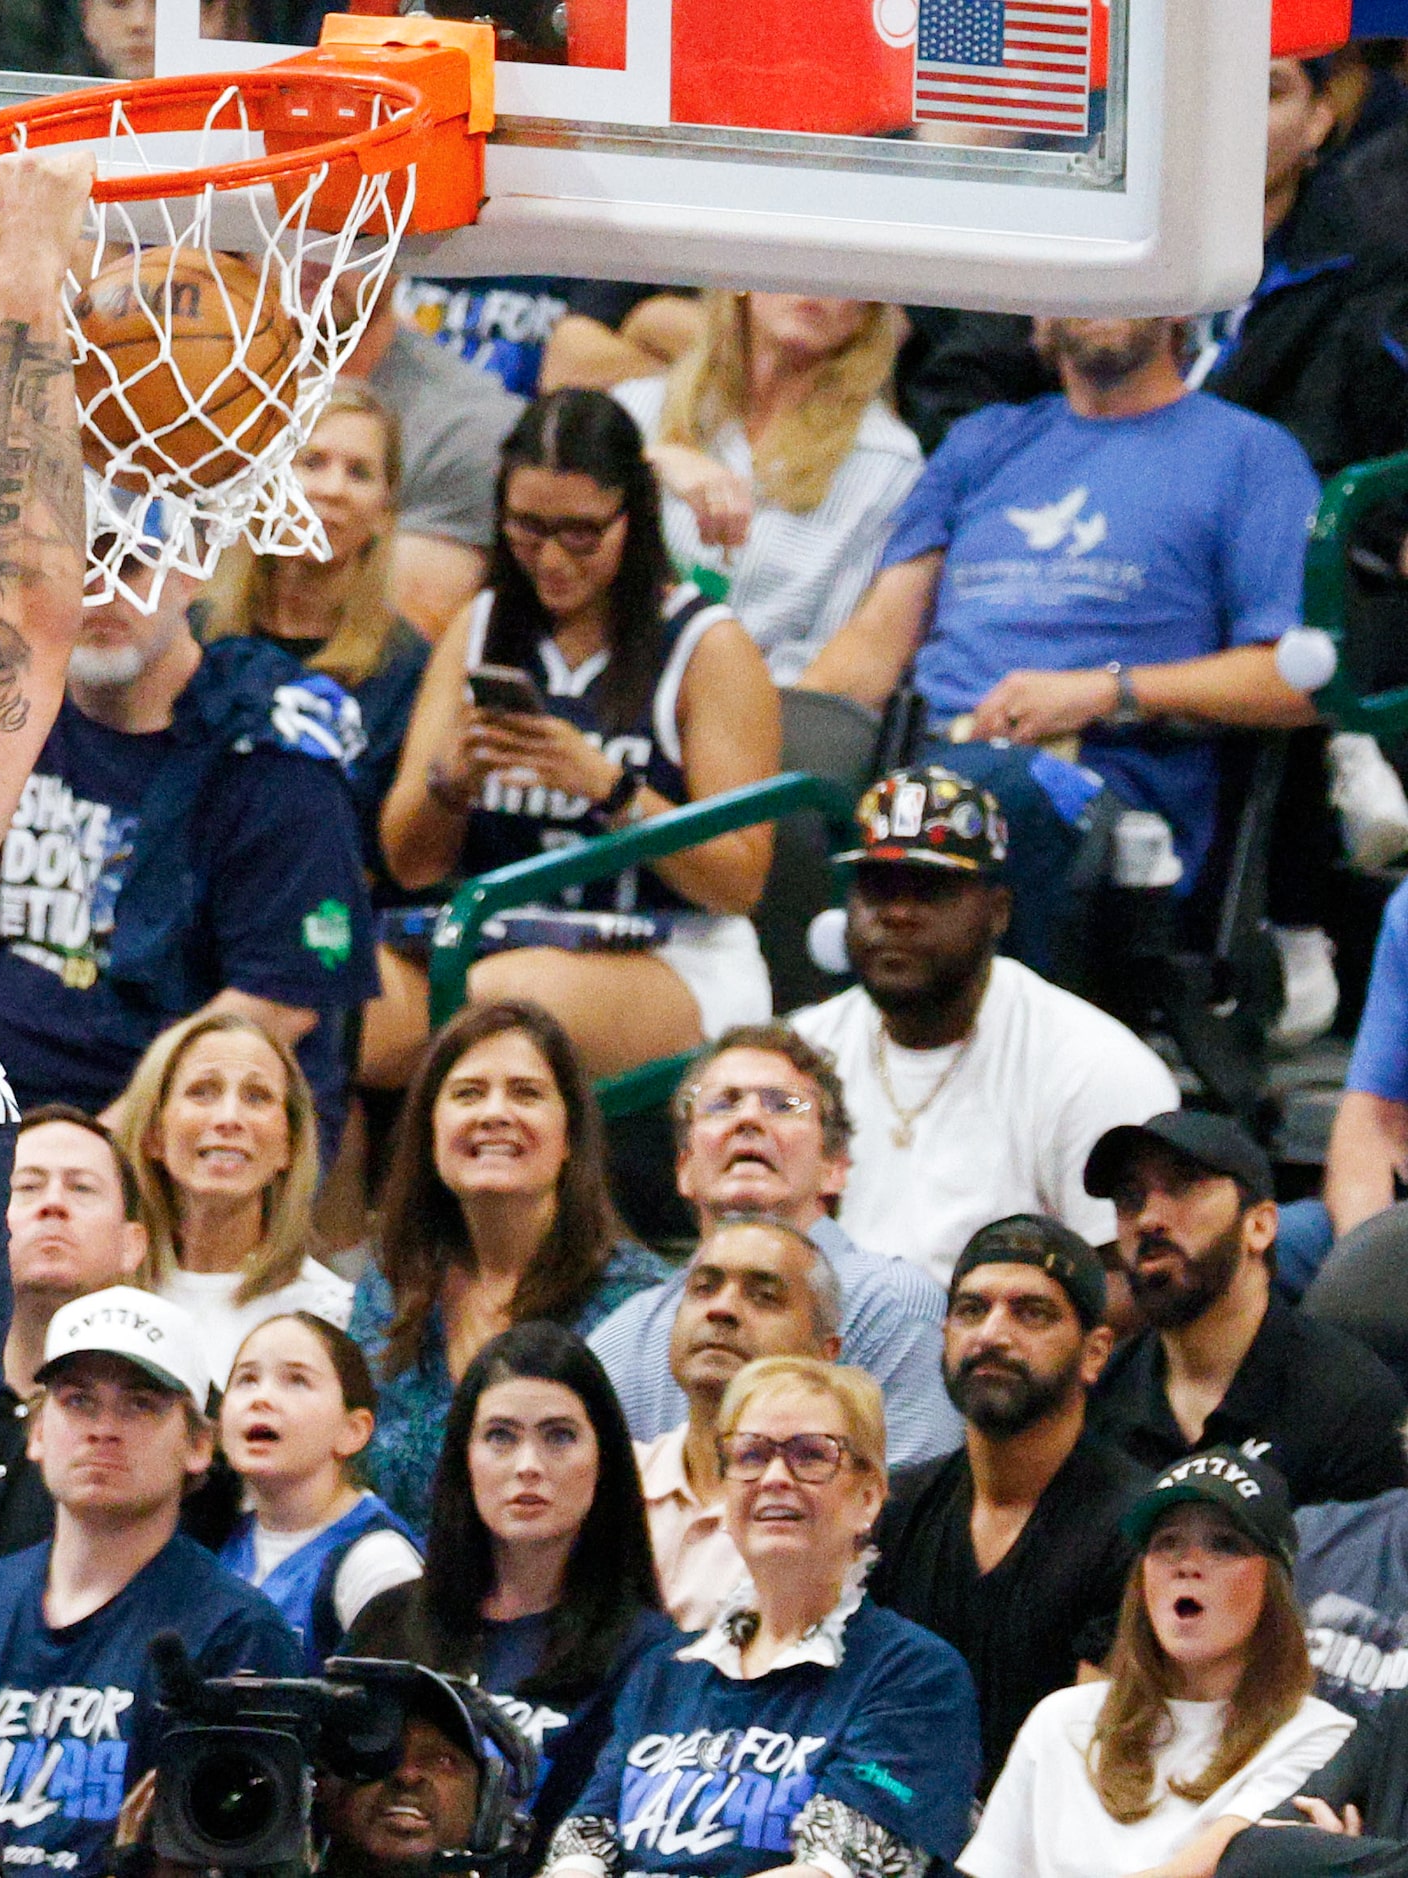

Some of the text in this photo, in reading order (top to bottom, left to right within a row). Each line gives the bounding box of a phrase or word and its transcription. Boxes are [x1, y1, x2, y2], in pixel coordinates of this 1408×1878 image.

[45, 1686, 134, 1744] FOR
[729, 1726, 826, 1781] FOR
[621, 1767, 739, 1856] ALL
